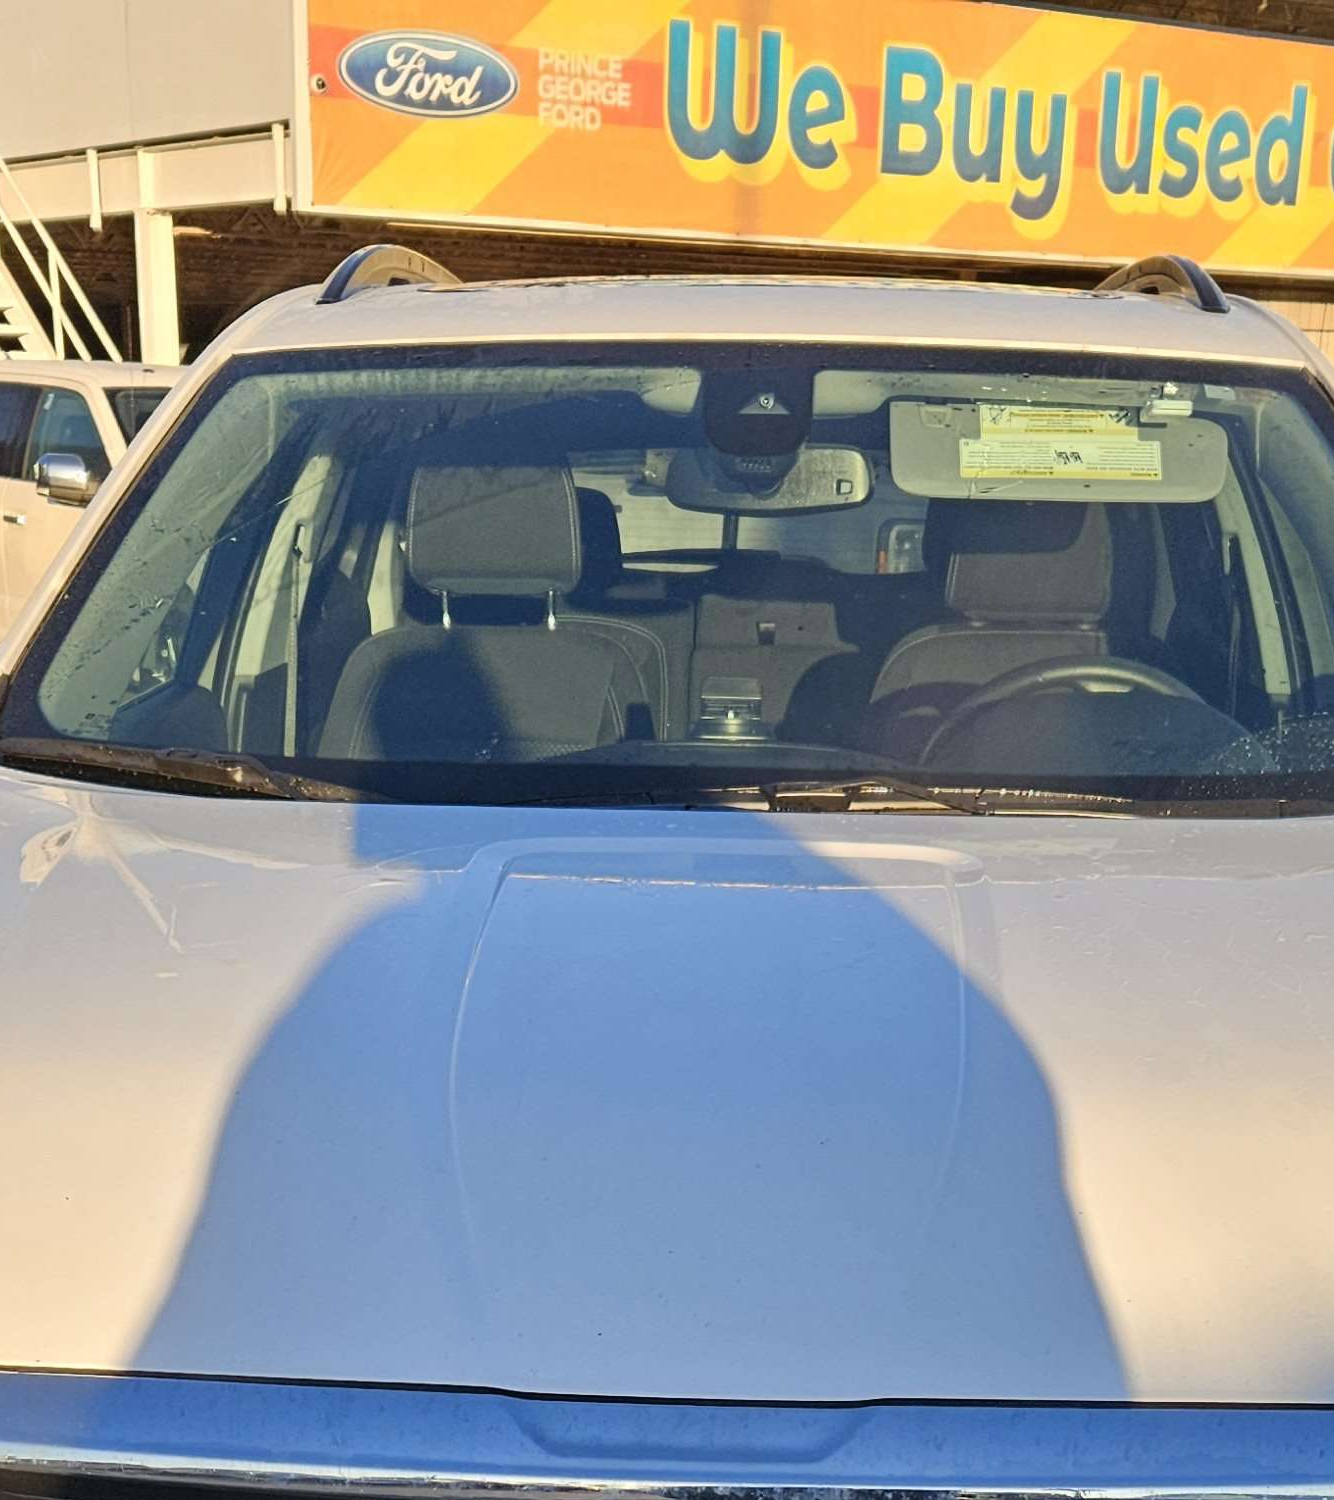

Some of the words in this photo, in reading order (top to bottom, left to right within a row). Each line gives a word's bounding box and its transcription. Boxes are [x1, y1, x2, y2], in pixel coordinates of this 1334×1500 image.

[374, 41, 484, 106] Ford
[538, 48, 623, 79] PRINCE
[538, 75, 632, 108] GEORGE
[538, 102, 602, 132] FORD
[667, 18, 845, 170] We
[880, 45, 1068, 221] Buy
[1099, 70, 1310, 207] Used
